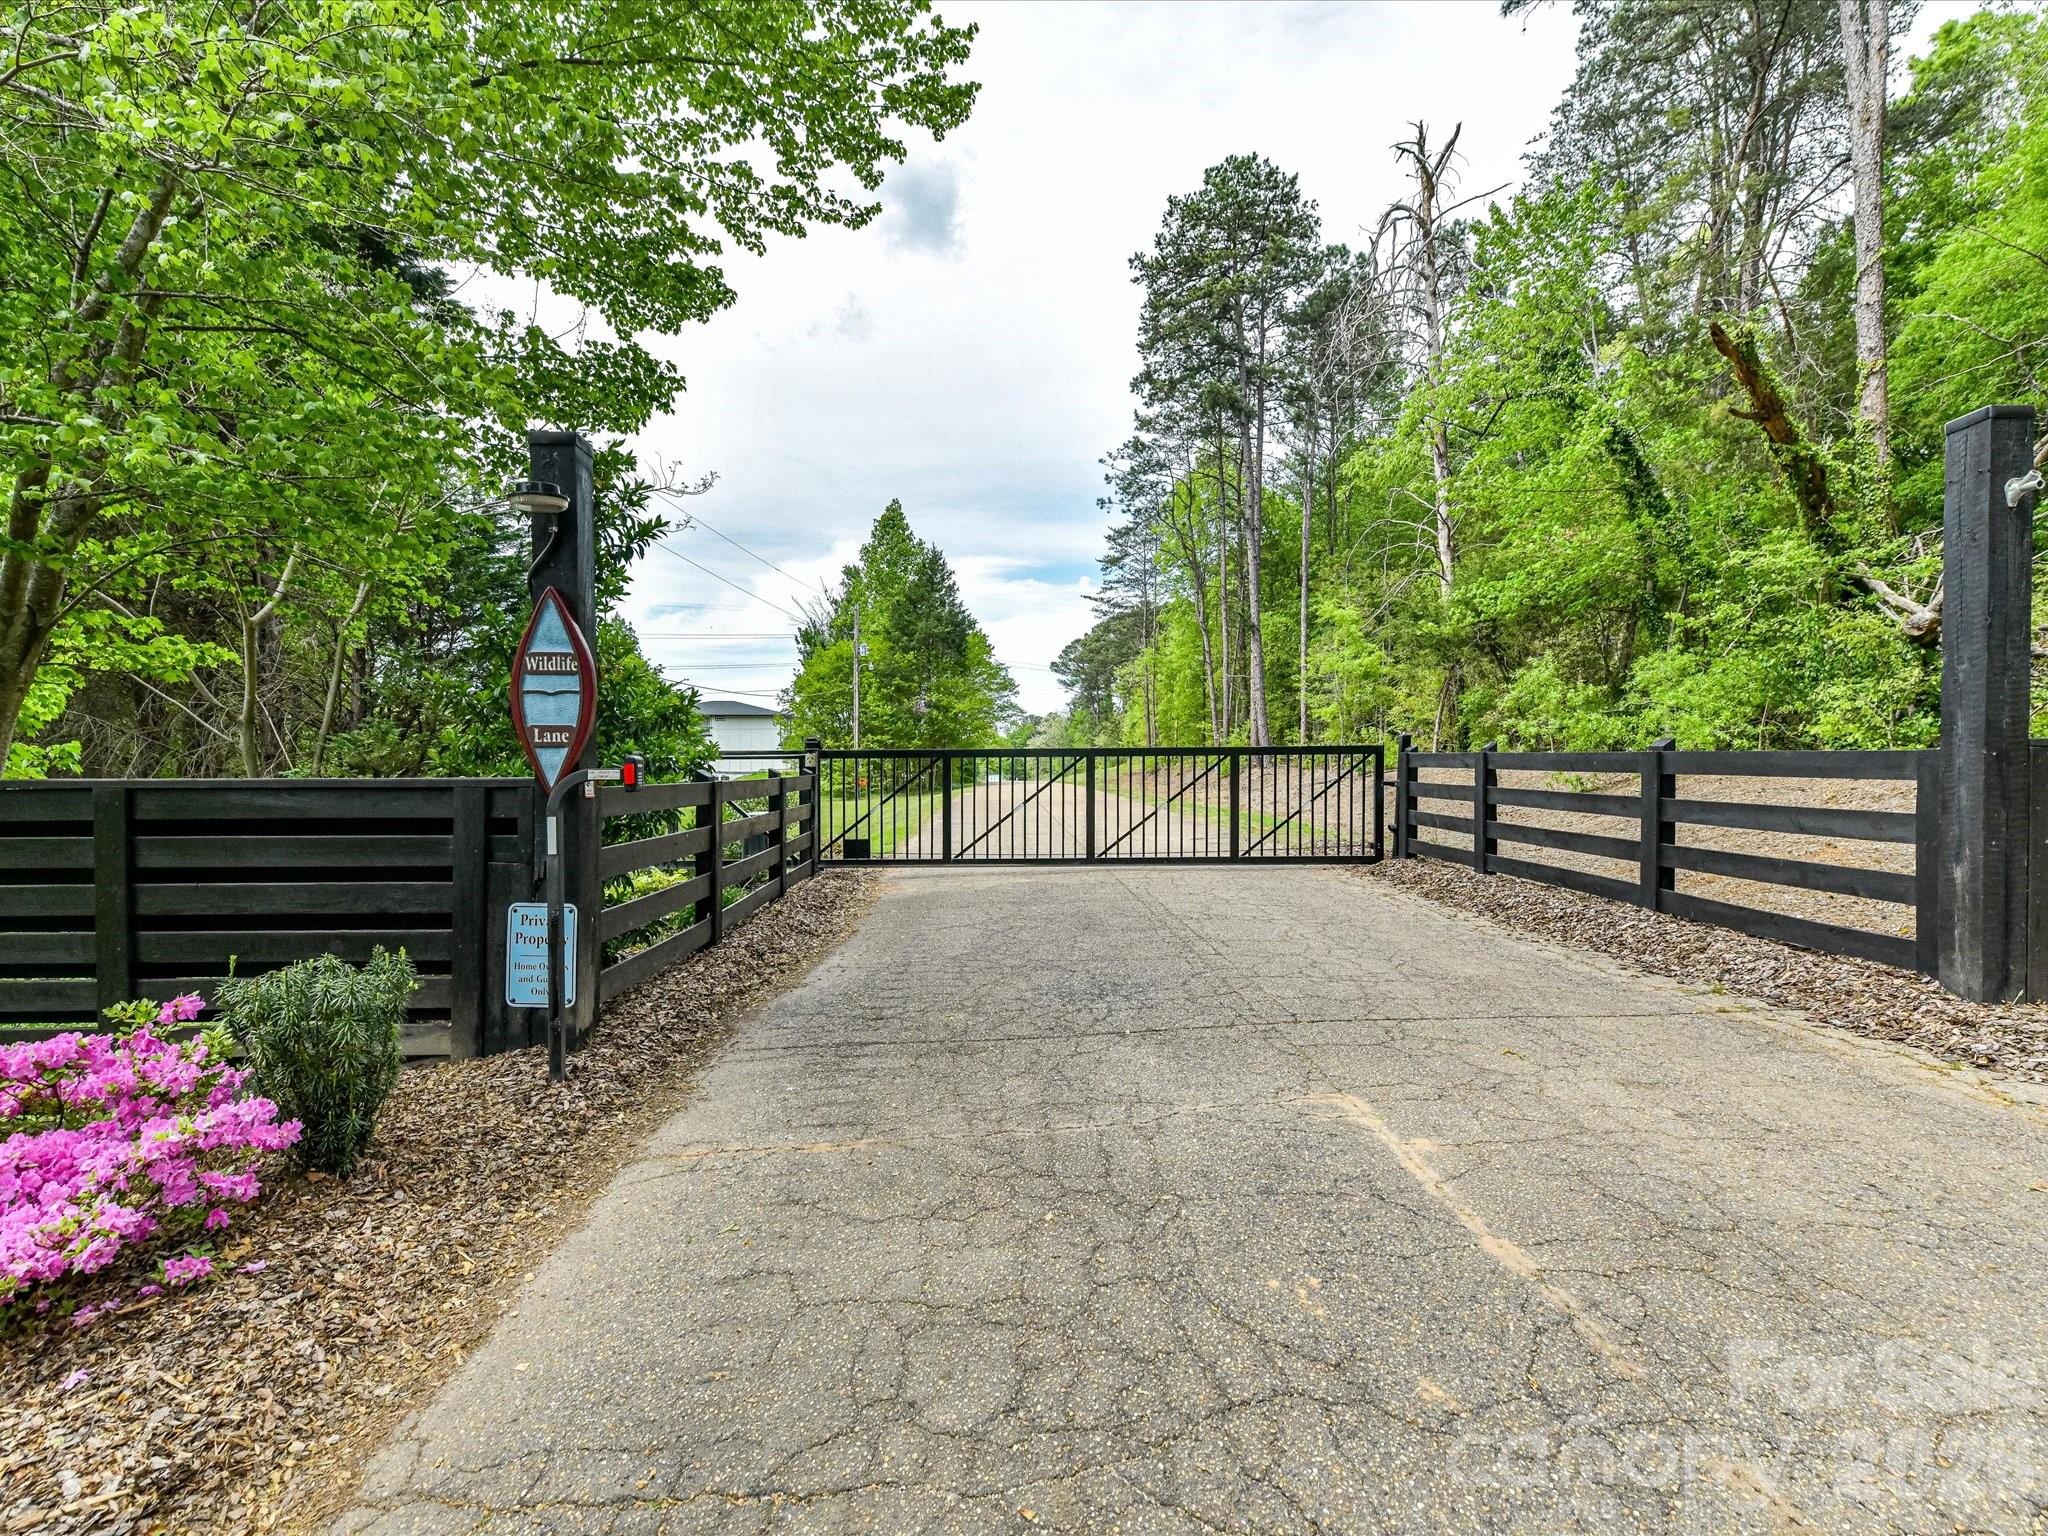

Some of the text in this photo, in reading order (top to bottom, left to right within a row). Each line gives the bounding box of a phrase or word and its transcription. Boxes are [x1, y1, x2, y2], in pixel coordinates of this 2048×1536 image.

[525, 655, 578, 671] Wildlife
[533, 728, 569, 743] Lane
[521, 914, 550, 927] Priv
[514, 962, 537, 971] Home
[518, 975, 534, 983] and
